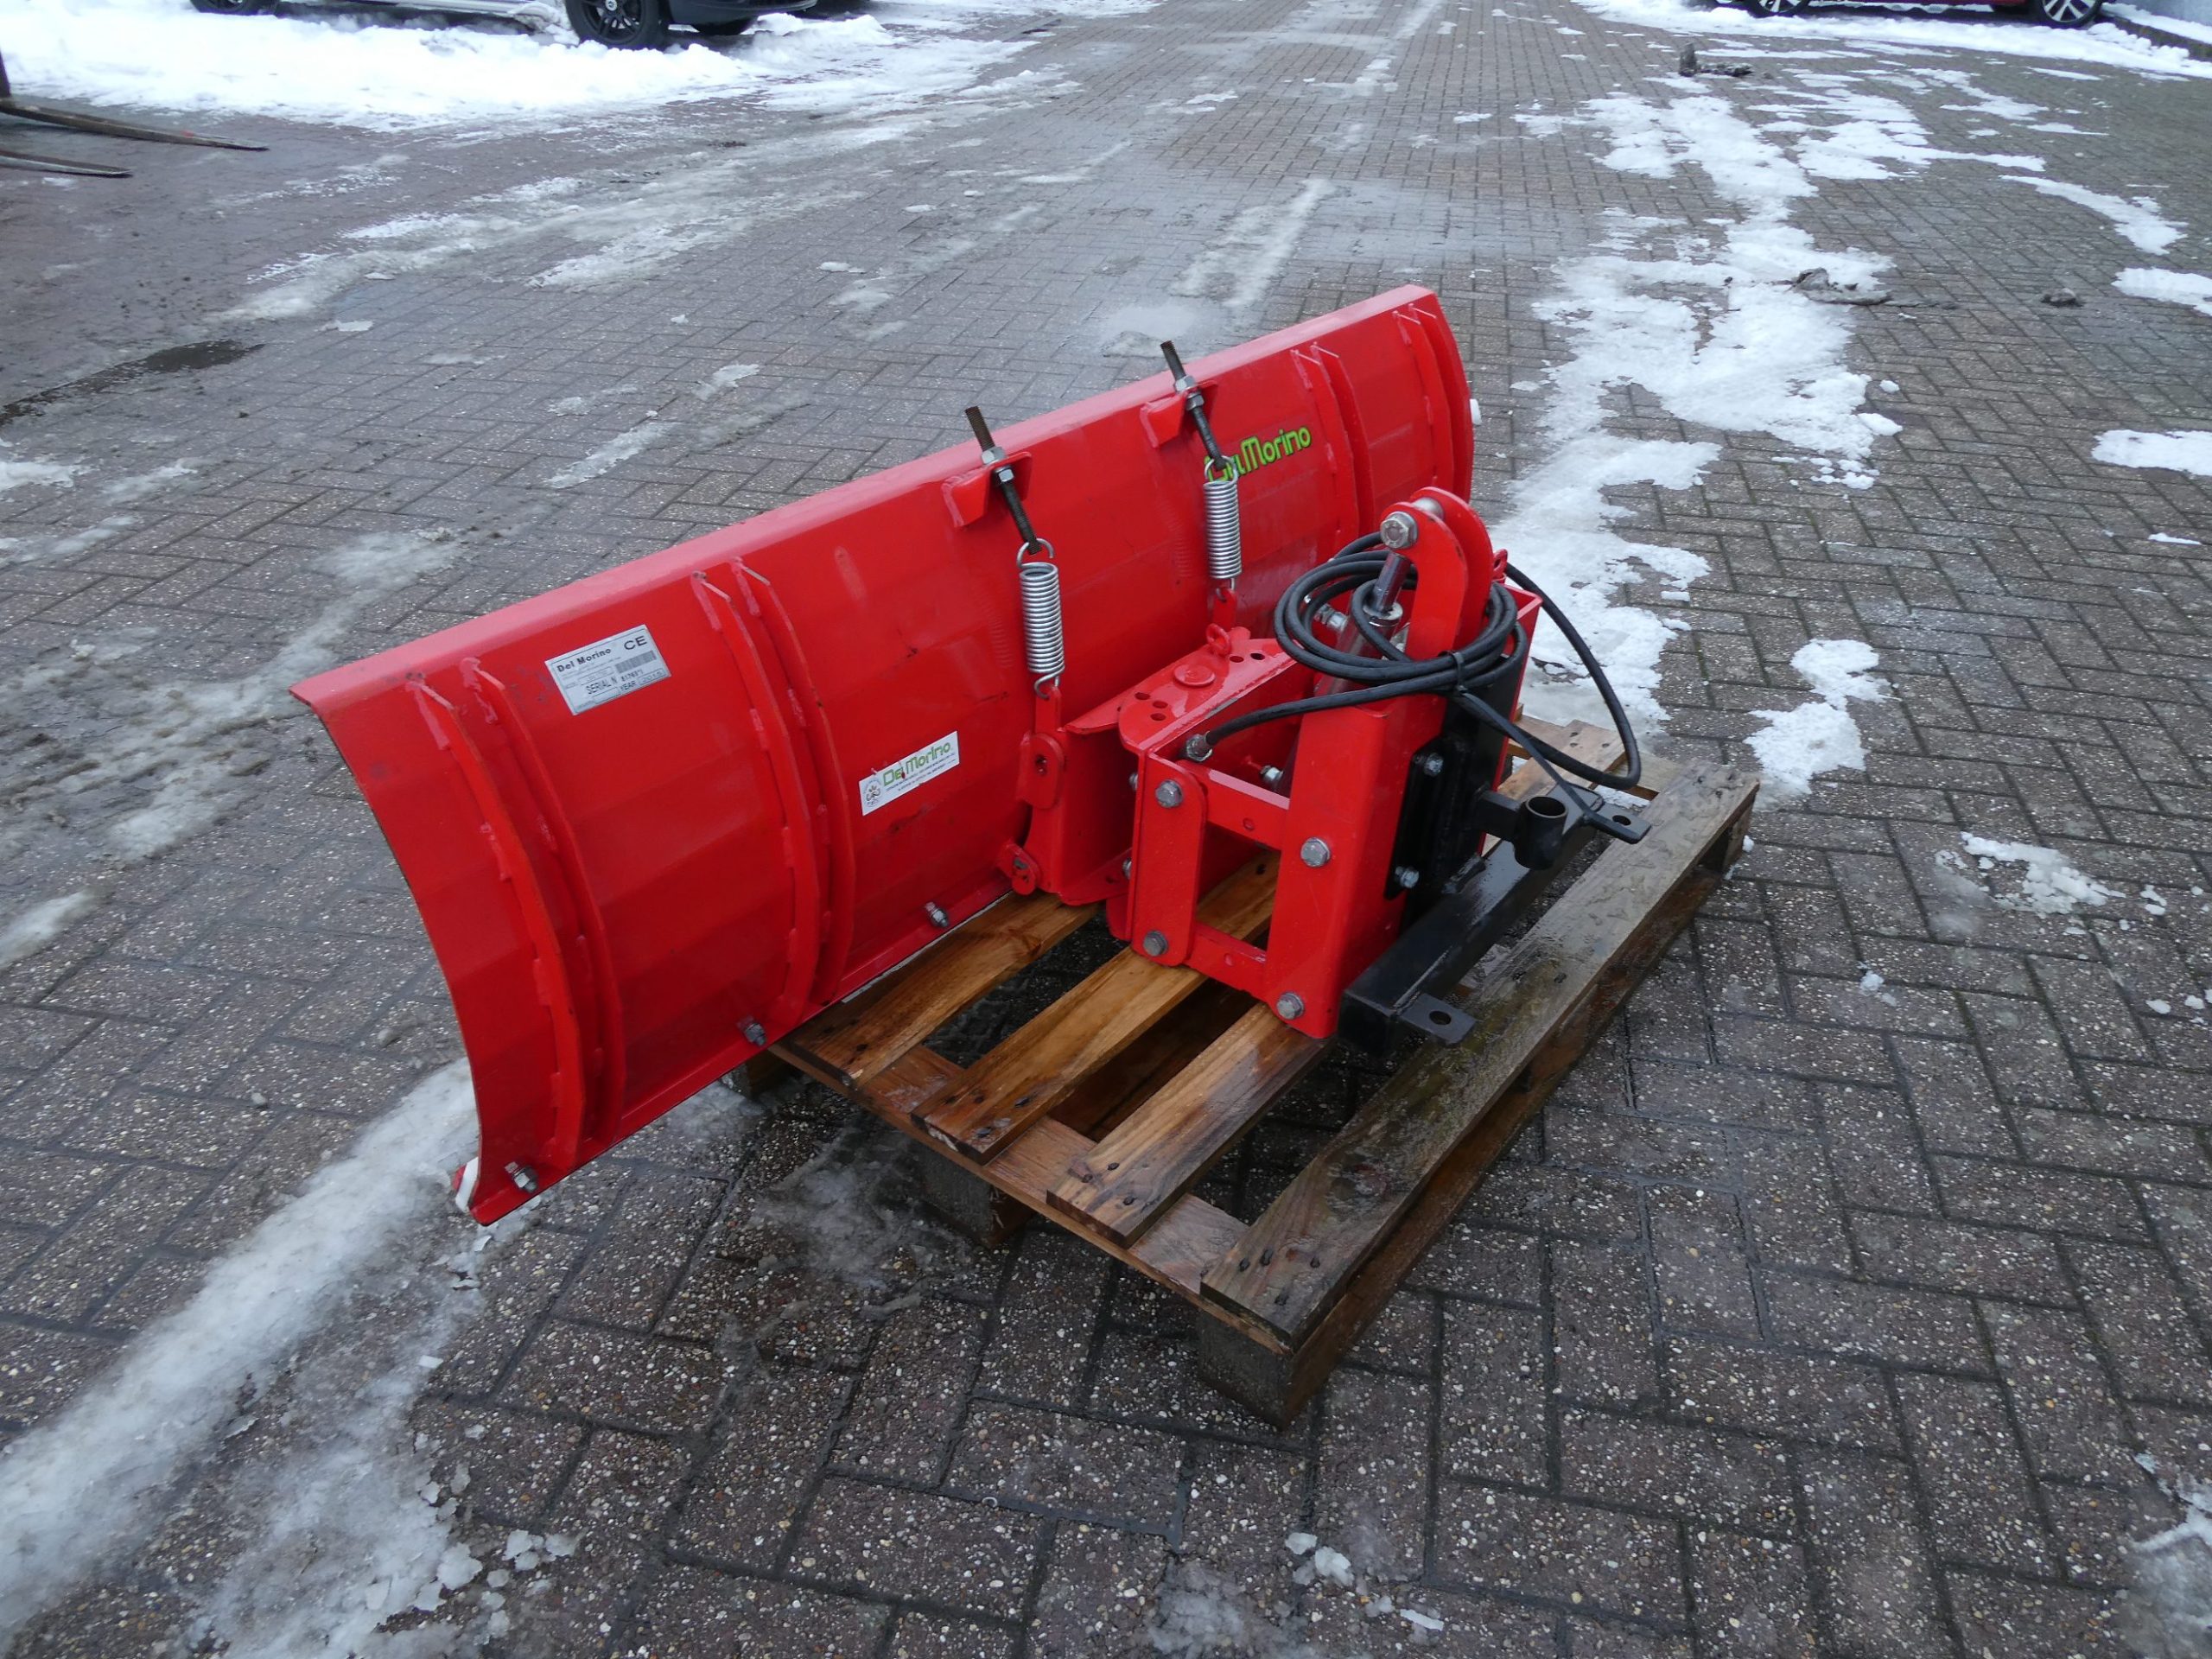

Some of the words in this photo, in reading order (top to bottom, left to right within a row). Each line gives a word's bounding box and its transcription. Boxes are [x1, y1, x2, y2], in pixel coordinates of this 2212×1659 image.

[1240, 426, 1312, 473] Morino
[624, 635, 647, 651] CE
[557, 661, 575, 672] Del
[577, 648, 611, 664] Morino
[586, 681, 611, 694] SERIAL
[620, 681, 636, 691] YEAR
[906, 742, 951, 773] Morino
